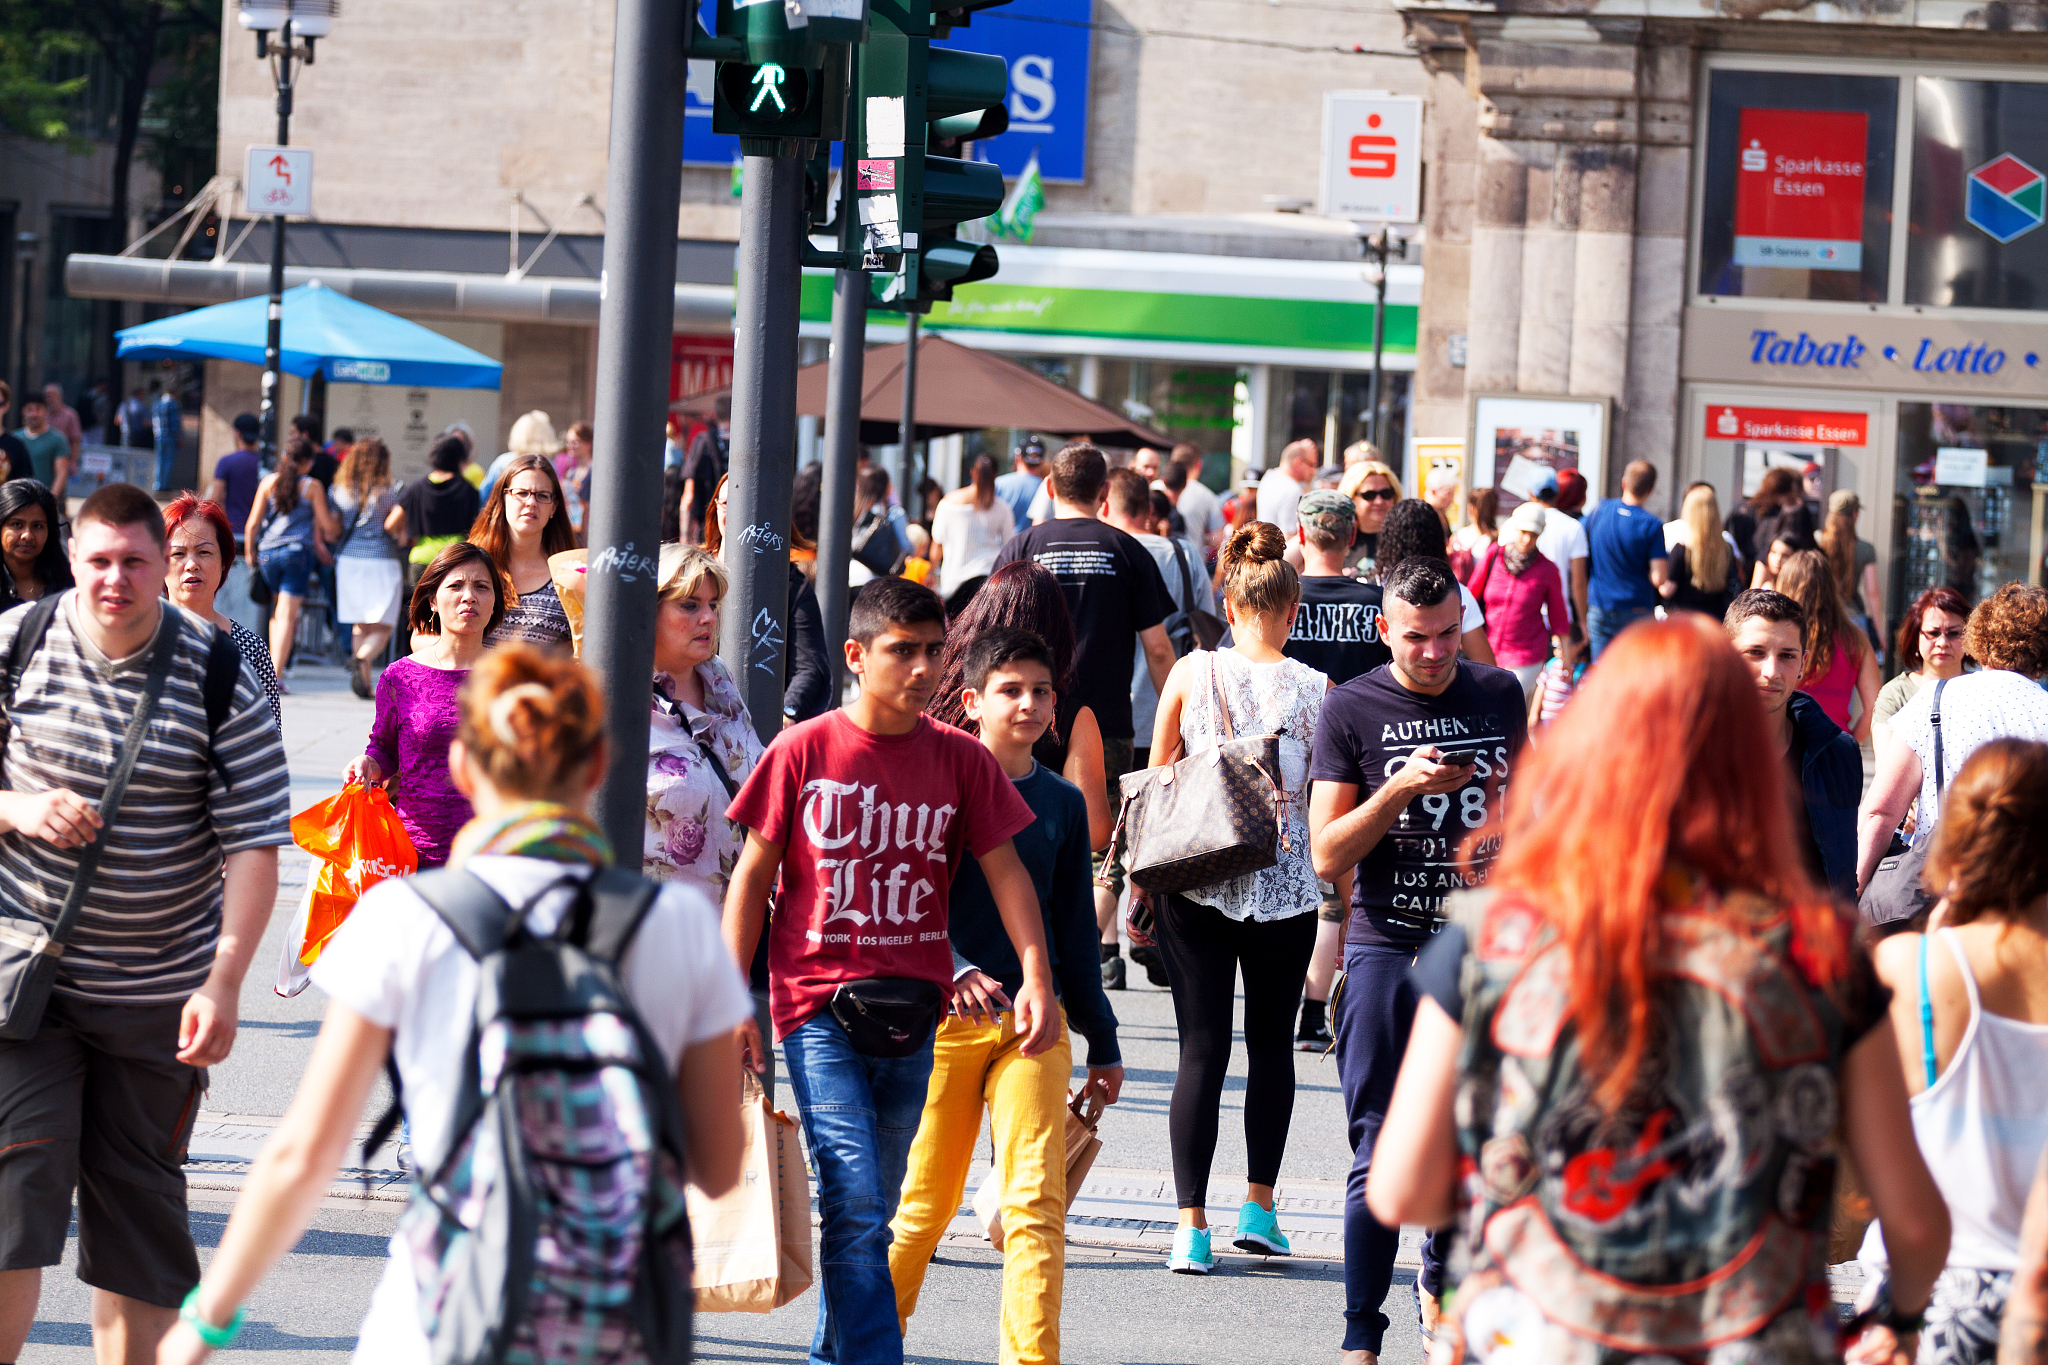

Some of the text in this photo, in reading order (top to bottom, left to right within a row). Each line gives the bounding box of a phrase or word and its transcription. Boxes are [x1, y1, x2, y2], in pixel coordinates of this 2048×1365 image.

[1774, 155, 1864, 177] Sparkasse
[1773, 177, 1825, 197] Essen
[1750, 329, 2006, 375] Tabak Lotto
[1743, 420, 1815, 441] Sparkasse
[1816, 424, 1859, 443] Essen
[799, 778, 957, 863] Thug
[1394, 870, 1428, 887] LOS
[816, 858, 934, 927] Life
[823, 933, 851, 944] YORK
[856, 935, 877, 946] LOS
